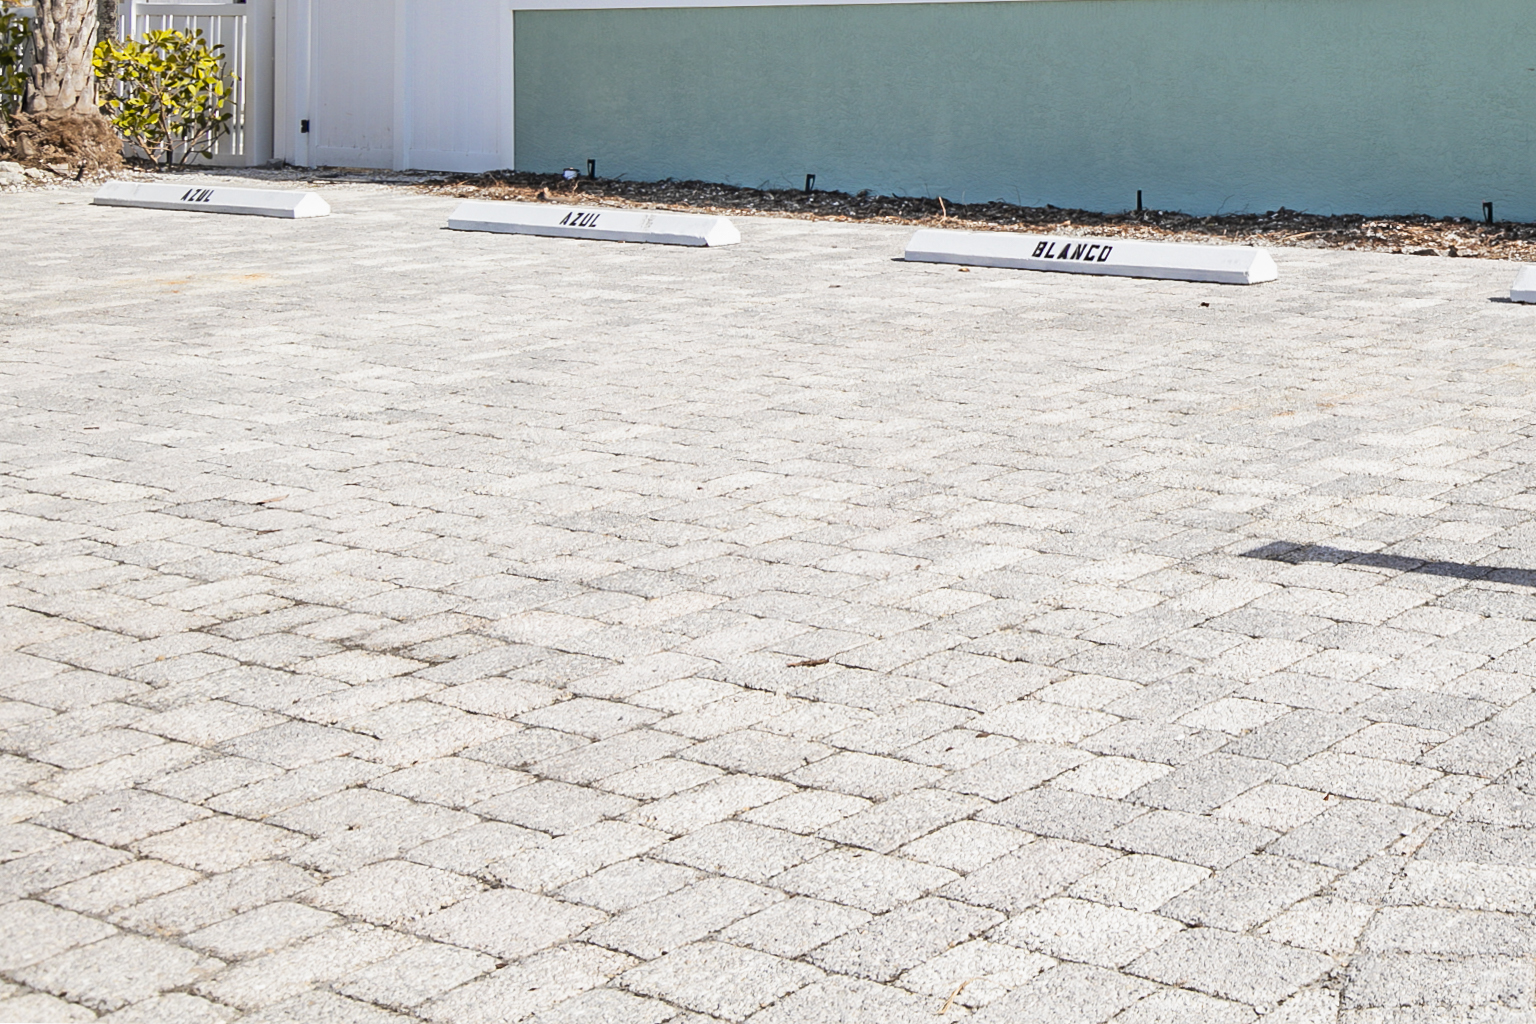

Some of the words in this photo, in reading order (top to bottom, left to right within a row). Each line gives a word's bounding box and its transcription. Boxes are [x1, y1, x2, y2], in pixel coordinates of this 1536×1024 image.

[180, 188, 215, 203] AZUL
[559, 211, 601, 228] AZUL
[1031, 241, 1114, 262] BLANCO
